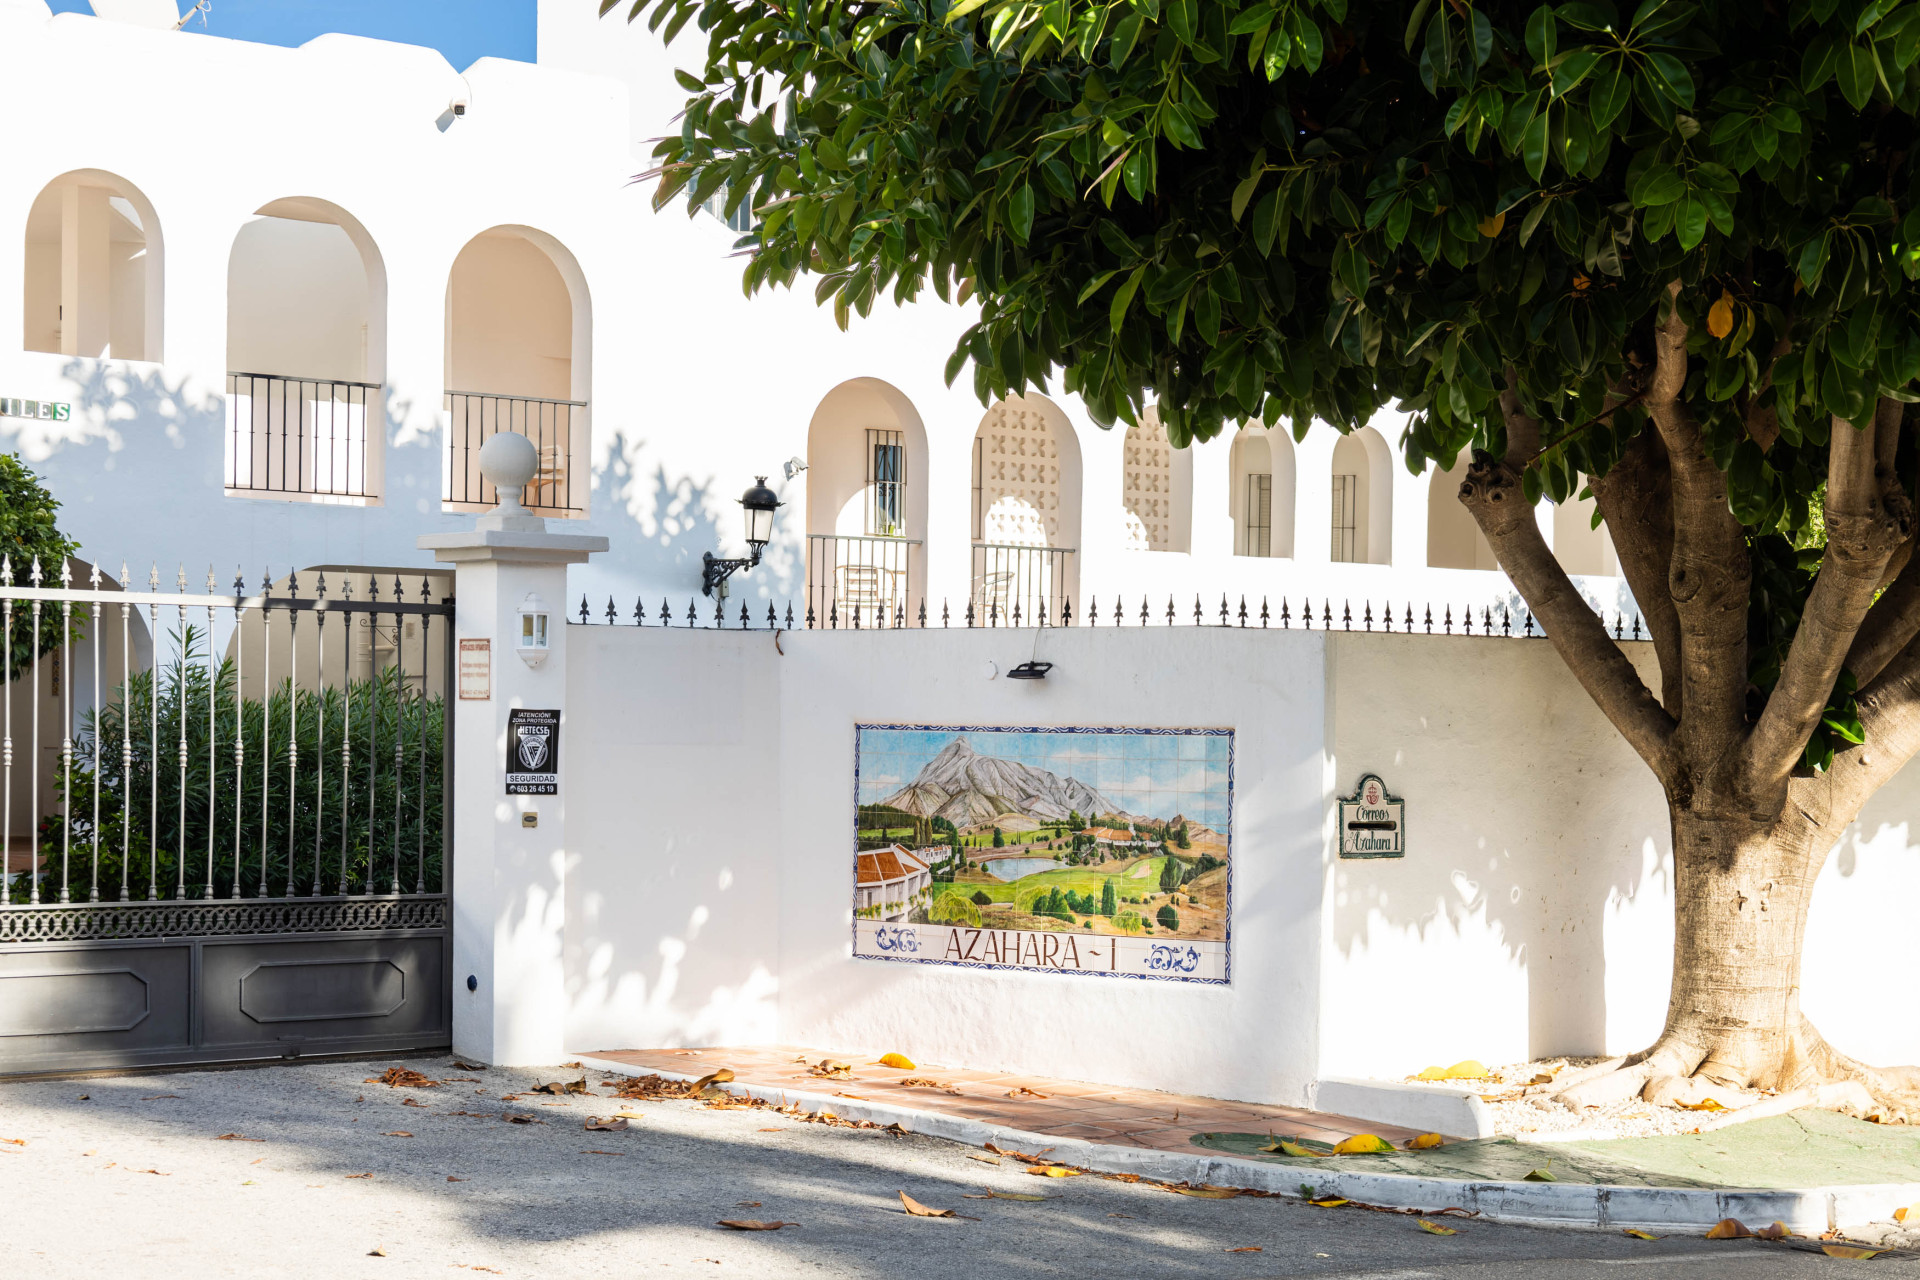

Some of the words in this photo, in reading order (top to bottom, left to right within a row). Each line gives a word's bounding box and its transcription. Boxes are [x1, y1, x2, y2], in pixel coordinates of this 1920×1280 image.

[519, 725, 548, 734] HETECSE
[1356, 805, 1389, 820] Correos
[1344, 830, 1390, 853] Azahara
[1394, 832, 1399, 850] I
[944, 928, 1080, 968] AZAHARA
